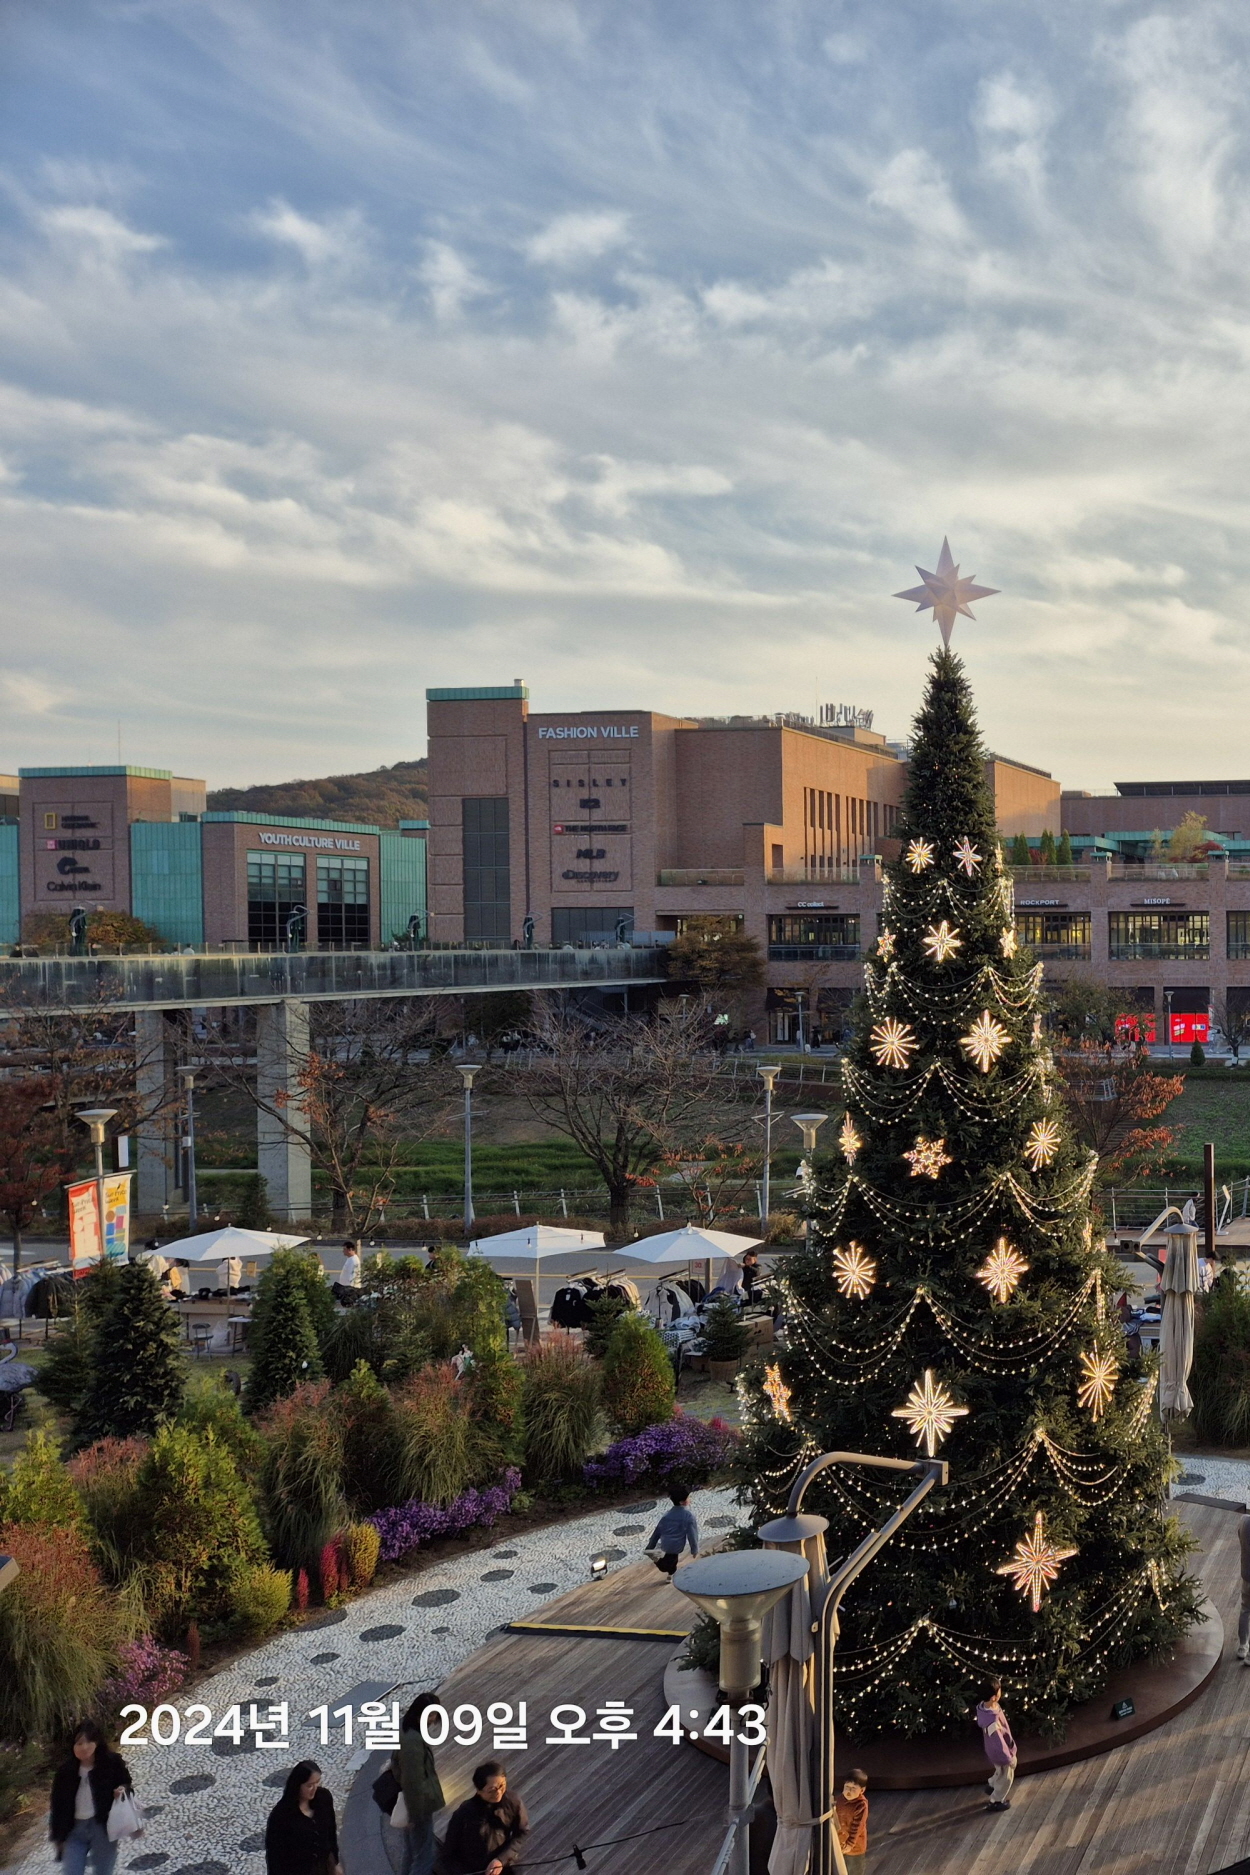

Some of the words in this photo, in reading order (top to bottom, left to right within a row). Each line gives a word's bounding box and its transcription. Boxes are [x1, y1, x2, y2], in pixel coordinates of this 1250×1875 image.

[538, 727, 598, 739] FASHION
[601, 726, 640, 738] VILLE
[552, 778, 627, 788] SISLEY
[259, 832, 292, 846] YOUTH
[292, 835, 334, 849] CULTURE
[335, 838, 361, 851] VILLE
[576, 849, 606, 859] MLB
